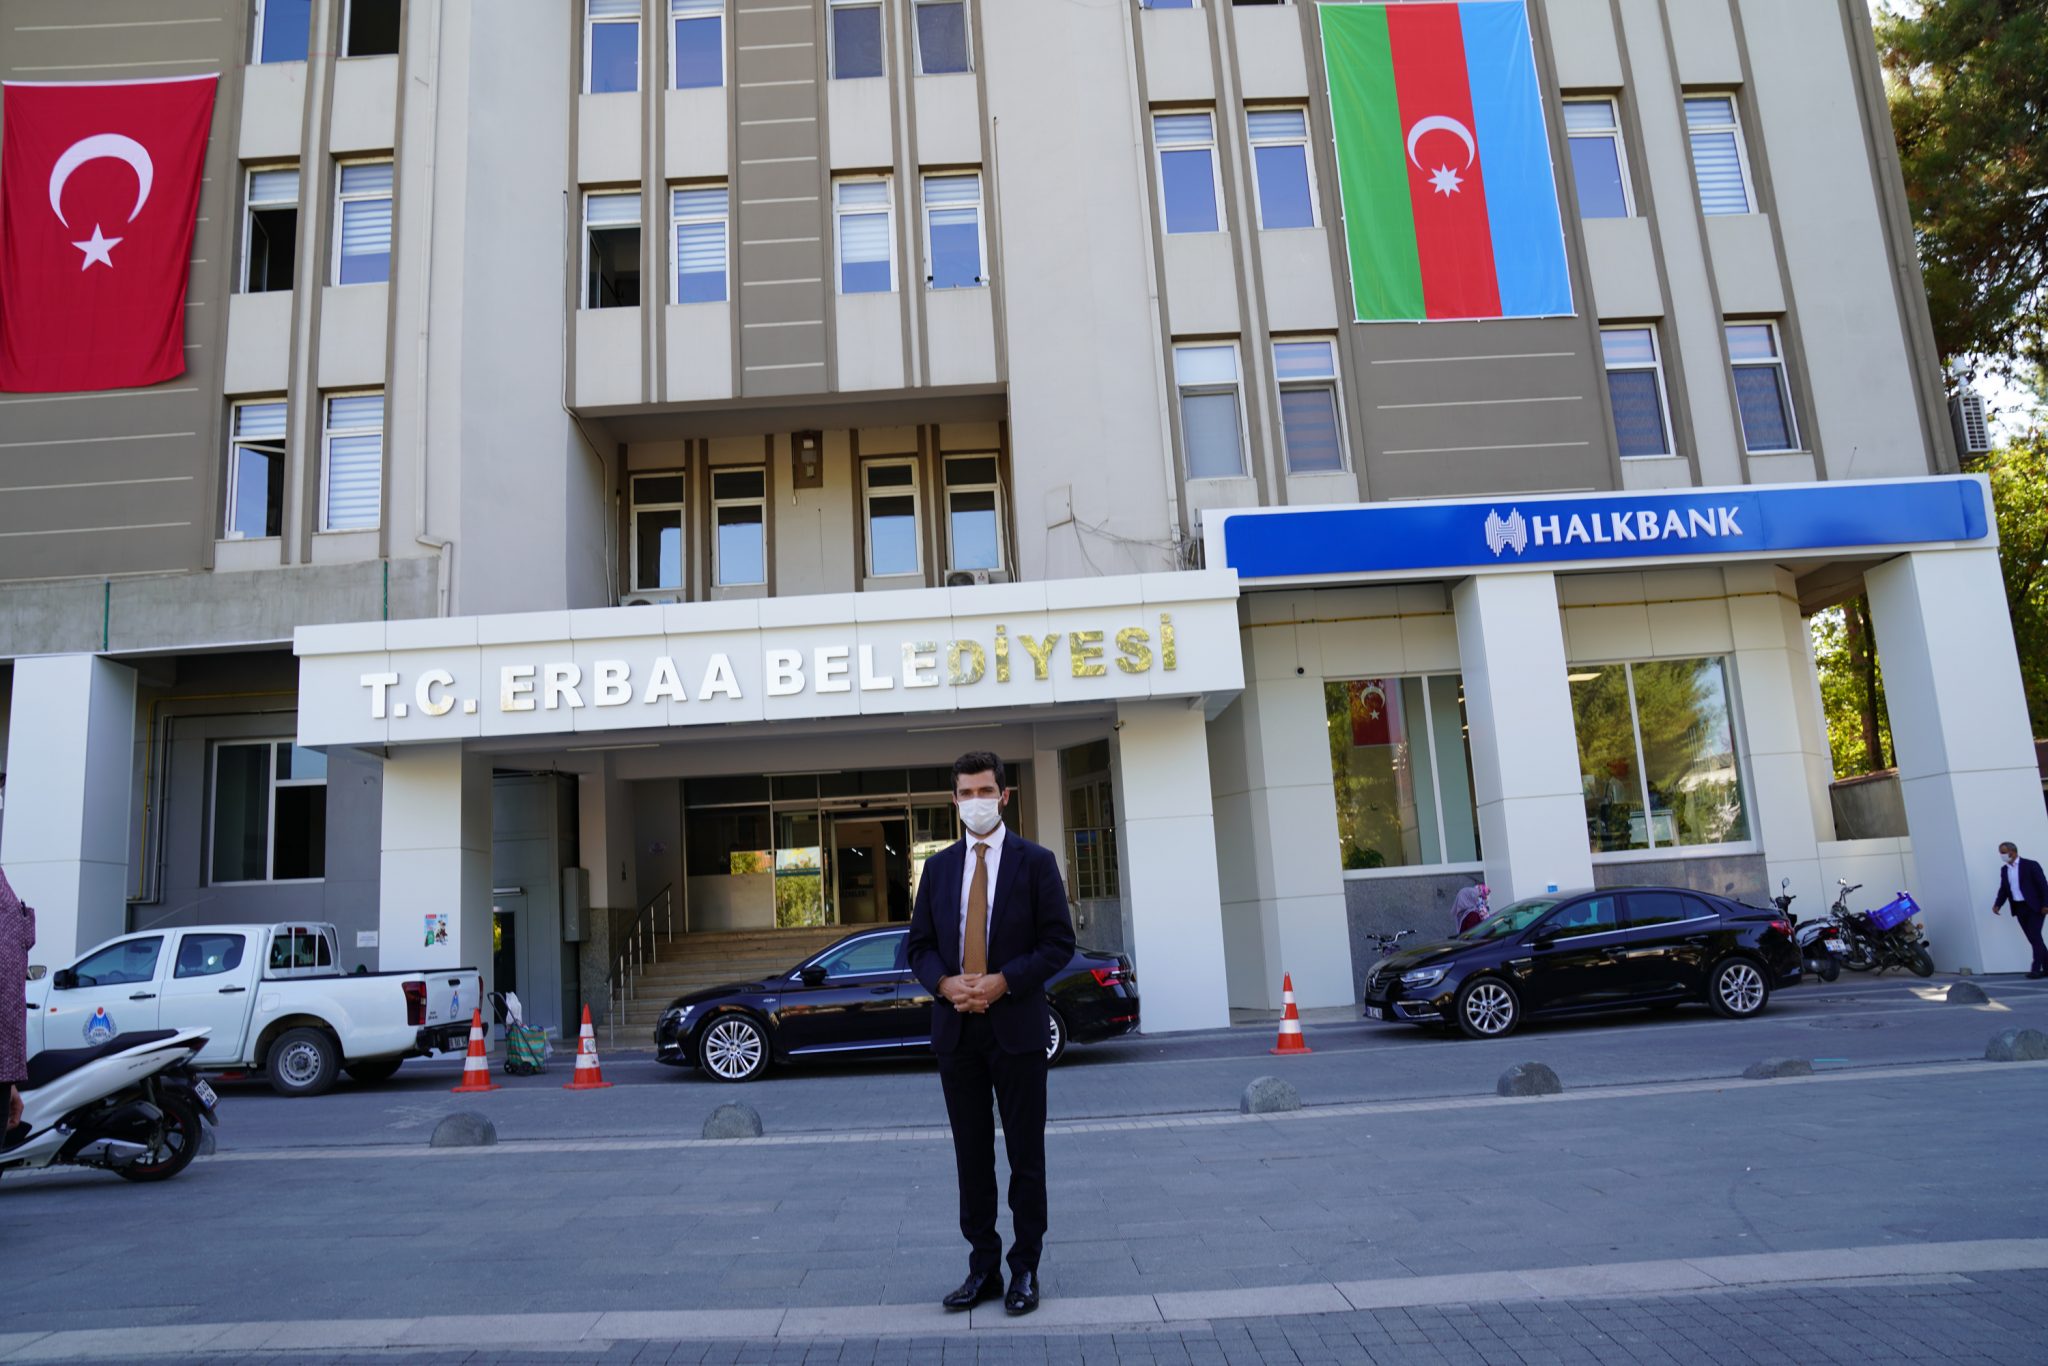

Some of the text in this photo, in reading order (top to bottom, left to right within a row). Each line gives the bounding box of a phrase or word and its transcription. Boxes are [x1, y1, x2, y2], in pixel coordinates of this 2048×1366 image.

[1532, 506, 1743, 546] HALKBANK
[360, 613, 1177, 719] T.C. ERBAA BELEDİYESİ
